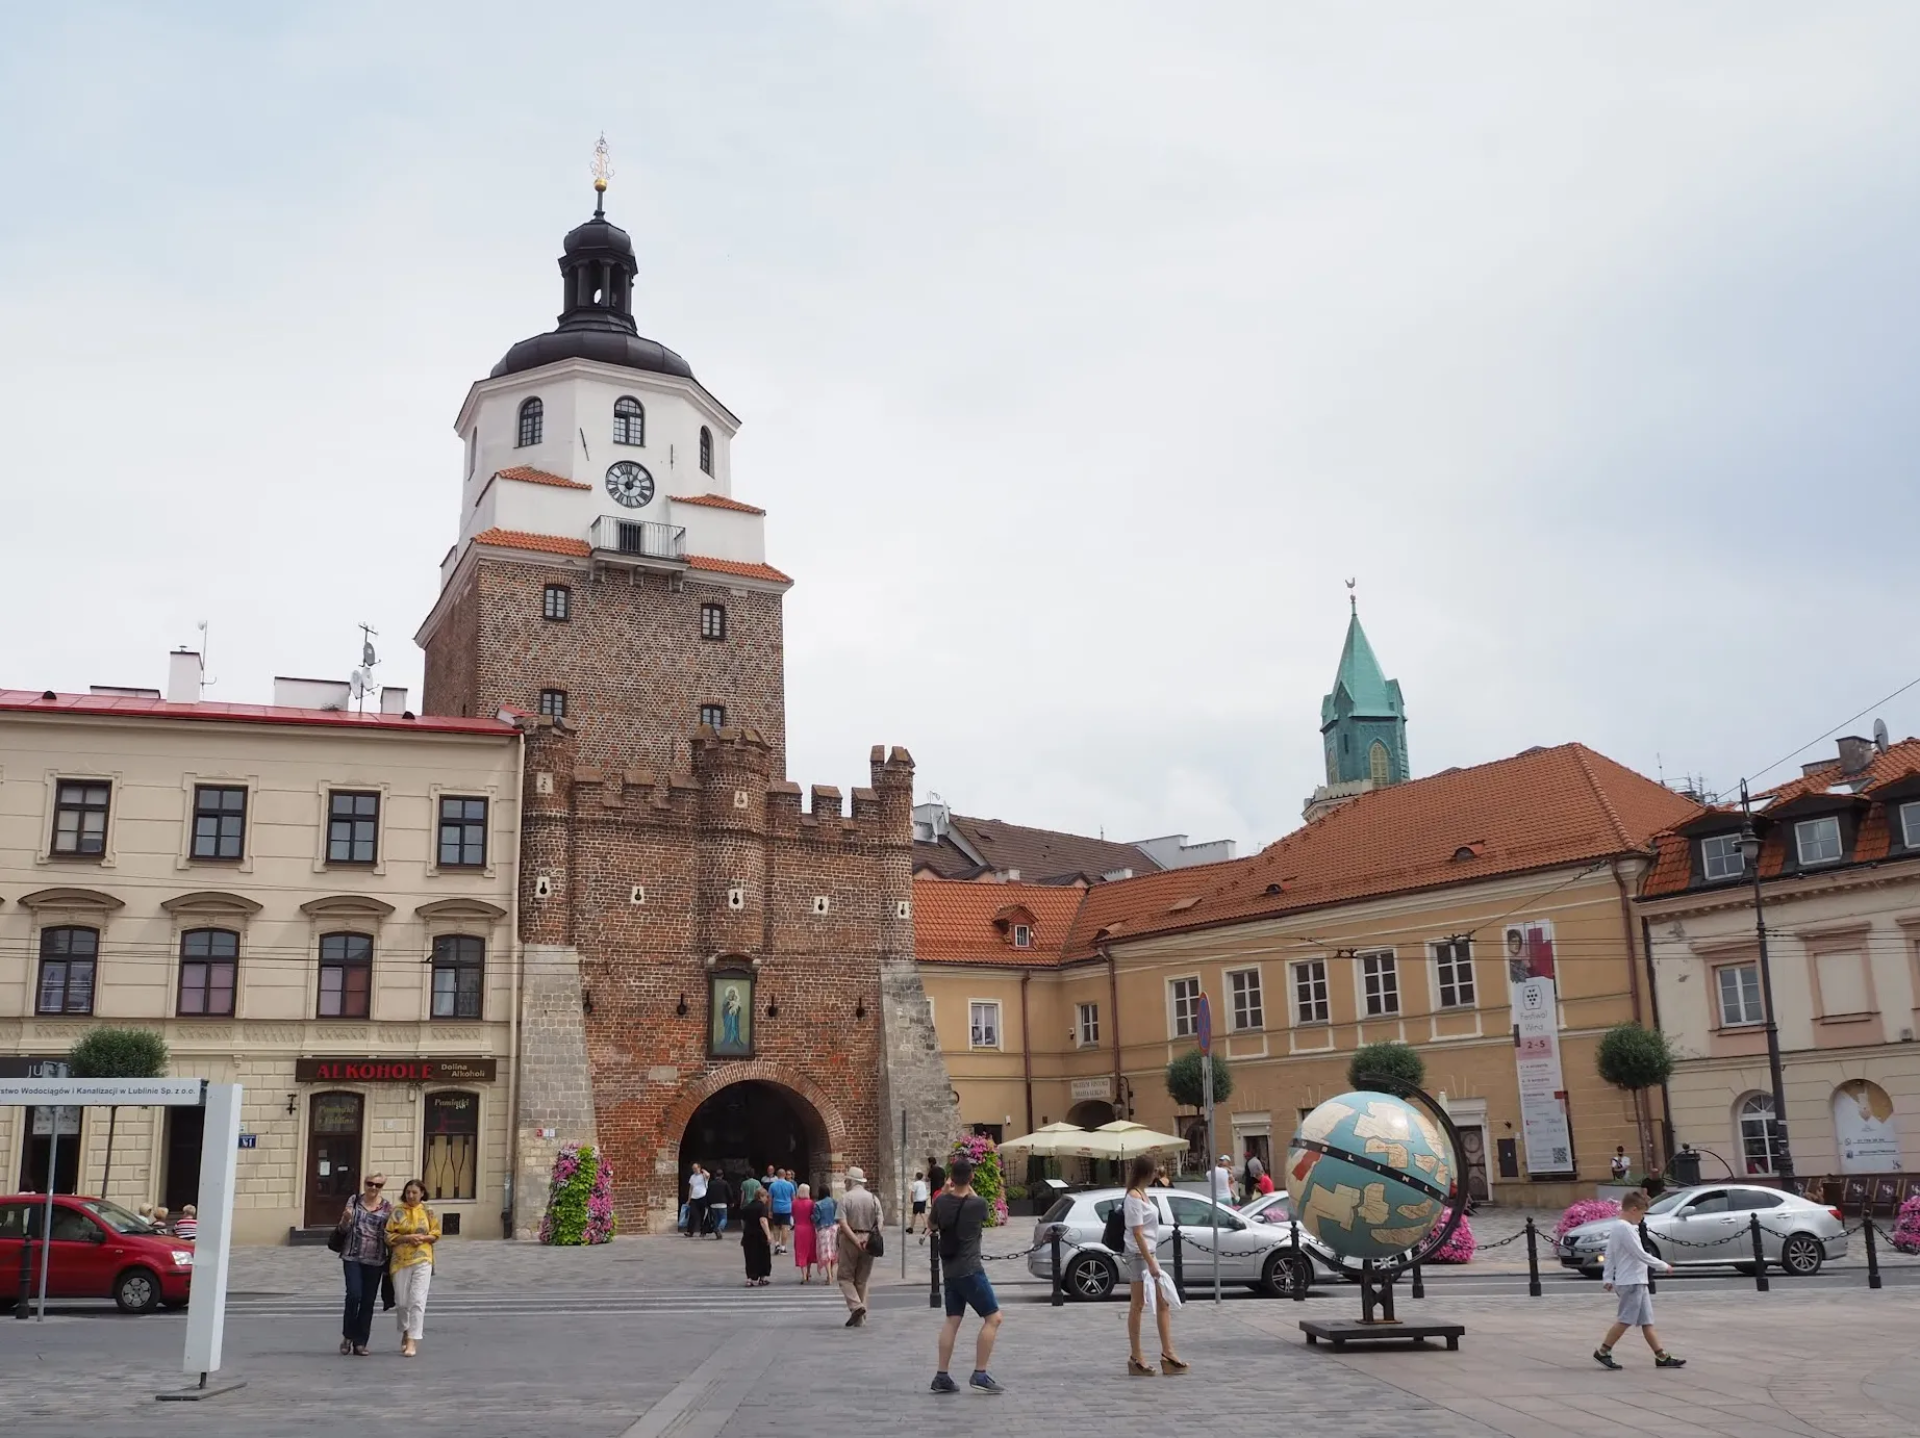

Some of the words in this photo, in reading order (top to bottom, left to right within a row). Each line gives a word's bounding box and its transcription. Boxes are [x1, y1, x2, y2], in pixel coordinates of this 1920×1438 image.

[317, 1063, 434, 1079] ALKOHOLE
[441, 1063, 468, 1071] Dolina
[451, 1069, 486, 1078] Alkoholi
[21, 1087, 70, 1096] Wodociągów
[76, 1087, 118, 1096] Kanalizacji
[128, 1086, 159, 1095] Lublinie
[160, 1086, 174, 1096] Sp.
